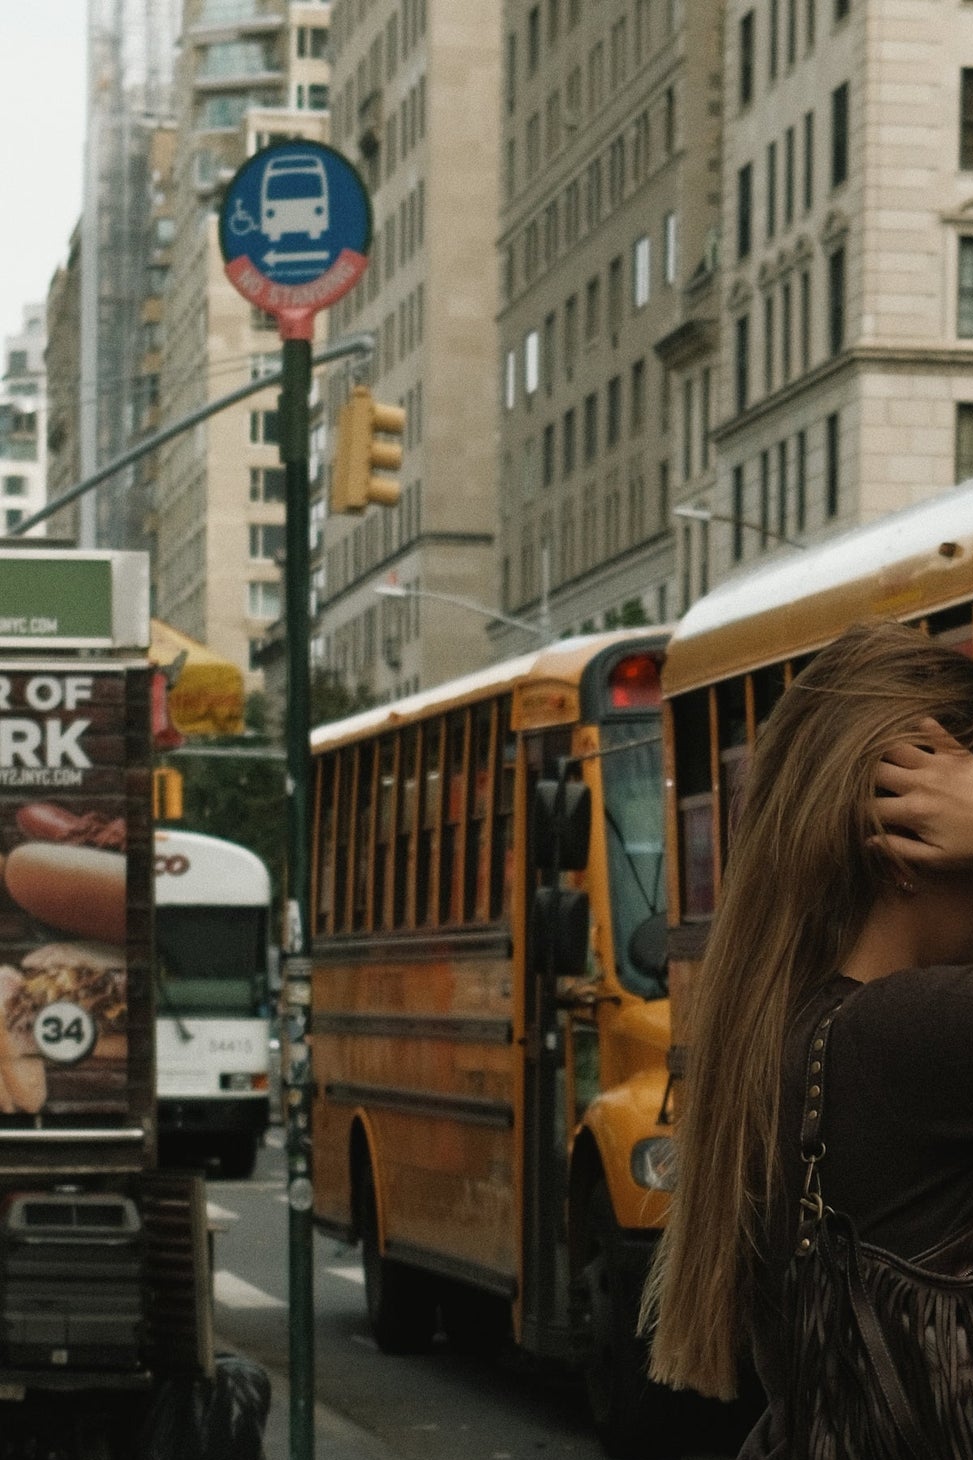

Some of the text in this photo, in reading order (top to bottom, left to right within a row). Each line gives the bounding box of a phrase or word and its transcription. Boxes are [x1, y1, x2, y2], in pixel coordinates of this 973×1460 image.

[25, 675, 94, 711] OF
[0, 717, 93, 769] RK
[42, 1016, 84, 1044] 34
